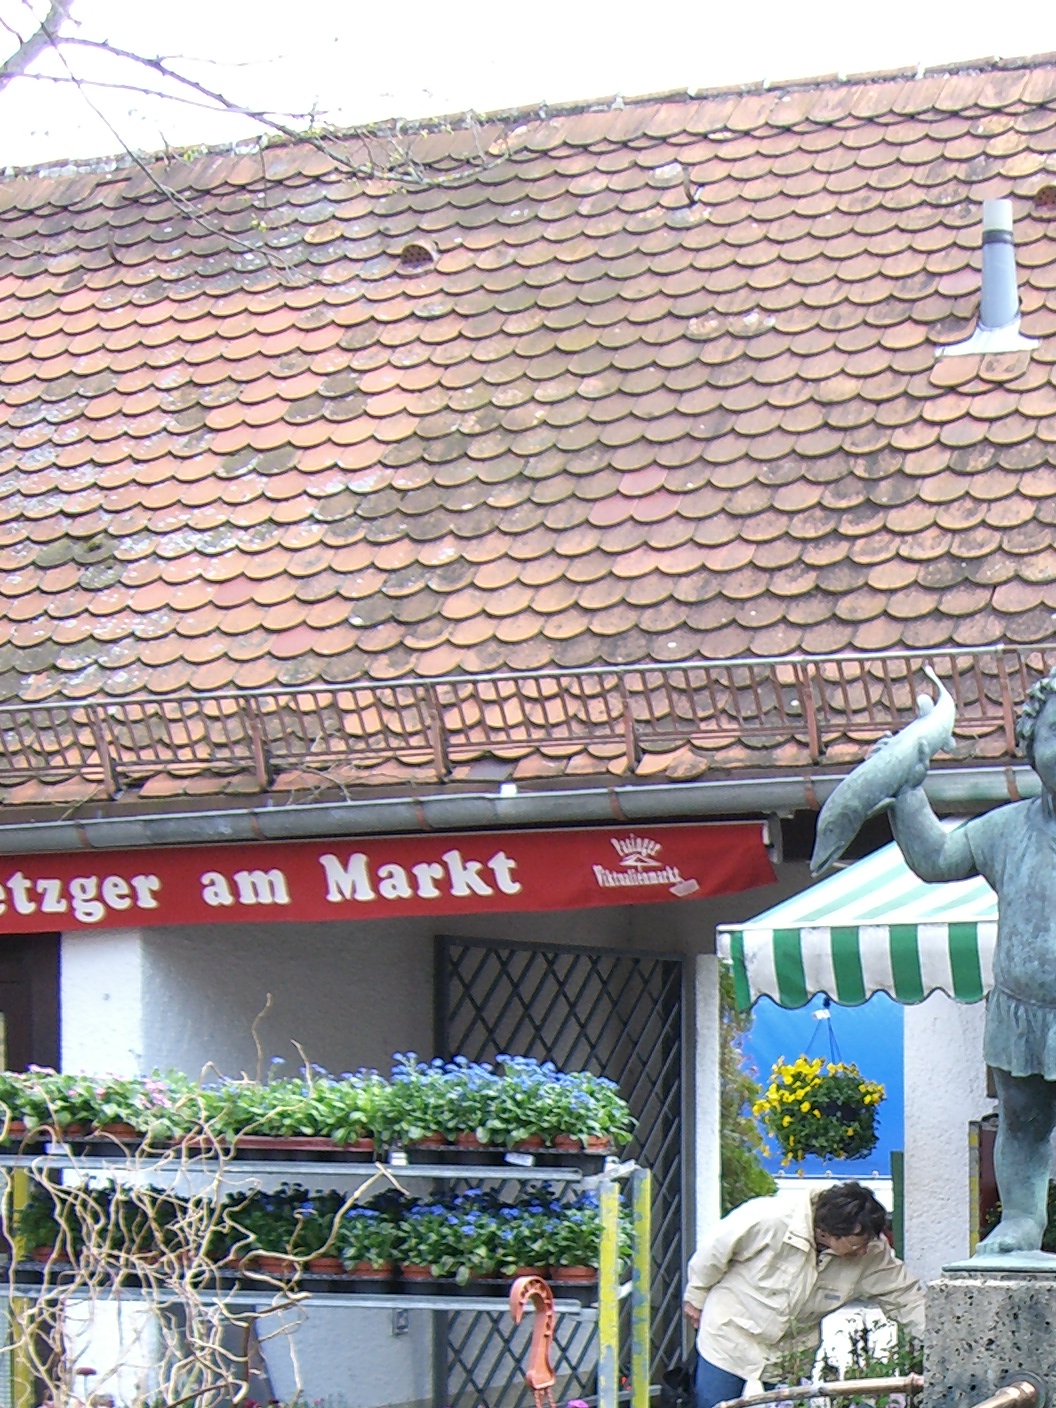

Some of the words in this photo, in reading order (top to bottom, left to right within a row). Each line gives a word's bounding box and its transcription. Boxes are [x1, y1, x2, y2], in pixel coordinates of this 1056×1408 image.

[610, 832, 664, 857] Pasinger
[0, 871, 161, 923] tzger
[200, 867, 291, 907] am
[318, 849, 523, 903] Markt
